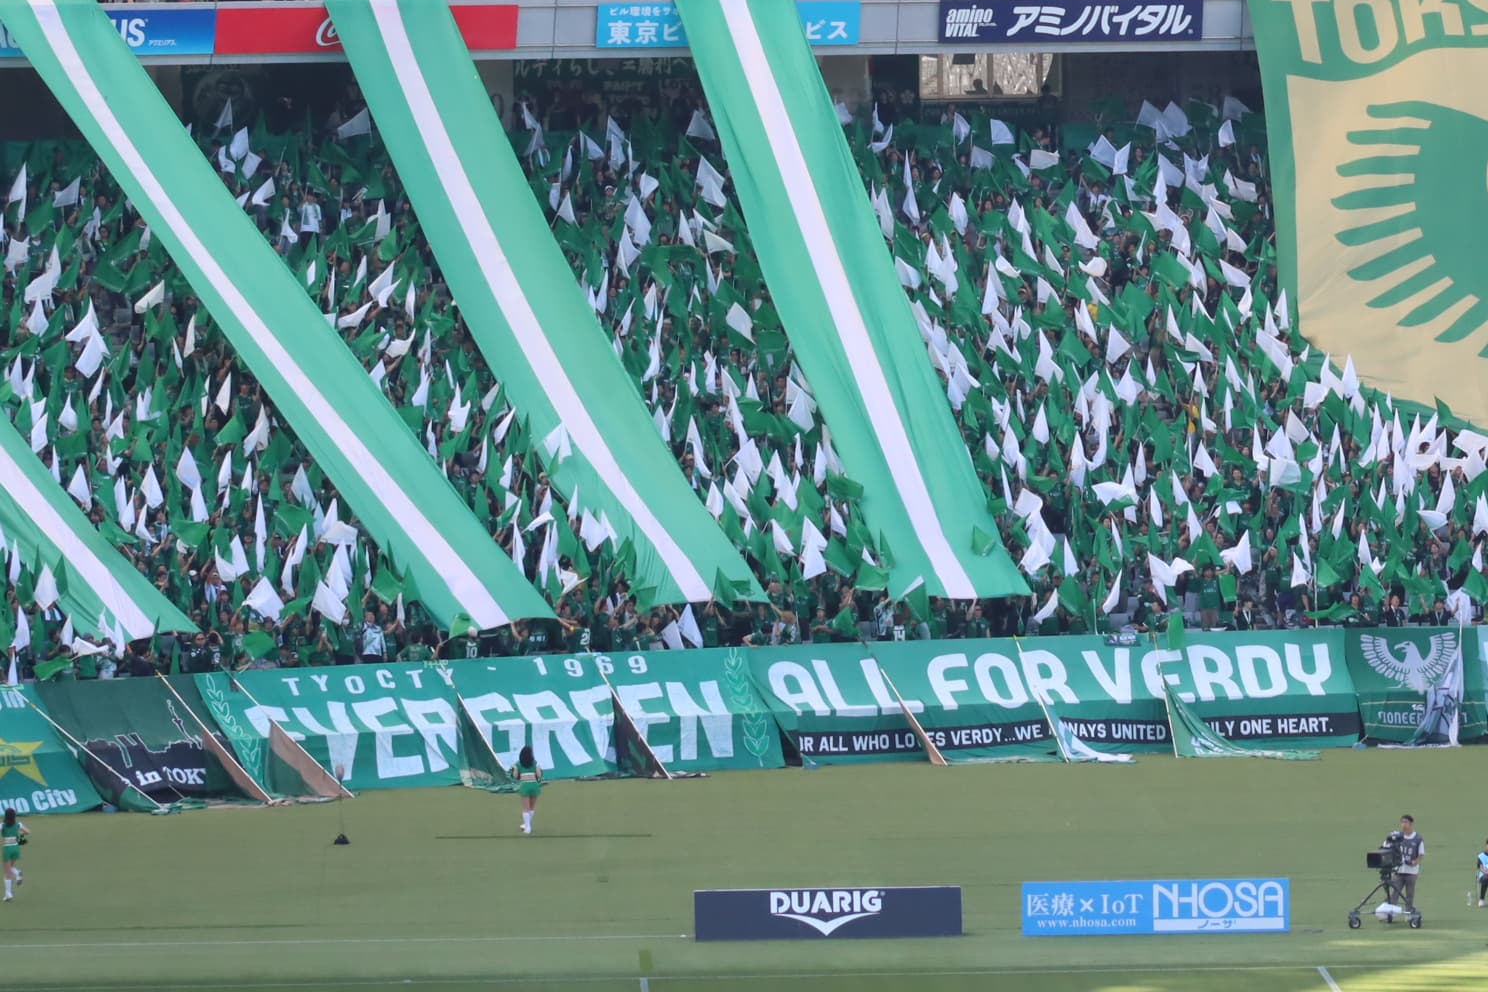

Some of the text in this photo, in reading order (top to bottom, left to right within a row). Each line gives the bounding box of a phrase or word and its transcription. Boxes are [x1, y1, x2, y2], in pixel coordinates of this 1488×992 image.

[946, 5, 993, 24] amino
[1007, 4, 1192, 37] アミノバイタル
[945, 22, 978, 37] VITAL
[533, 655, 648, 678] 1969
[767, 642, 1333, 718] ALL FOR VERDY
[819, 732, 850, 752] ALL
[853, 729, 891, 751] WHO
[895, 729, 946, 749] LOES
[1112, 723, 1167, 741] UNITED
[1240, 719, 1273, 736] ONE
[1278, 716, 1334, 735] HEART.
[137, 767, 206, 786] in TOK
[31, 789, 78, 810] City
[770, 890, 882, 914] DUARIG
[1153, 881, 1283, 917] NHOSA
[1037, 917, 1137, 928] www.nhosa.com
